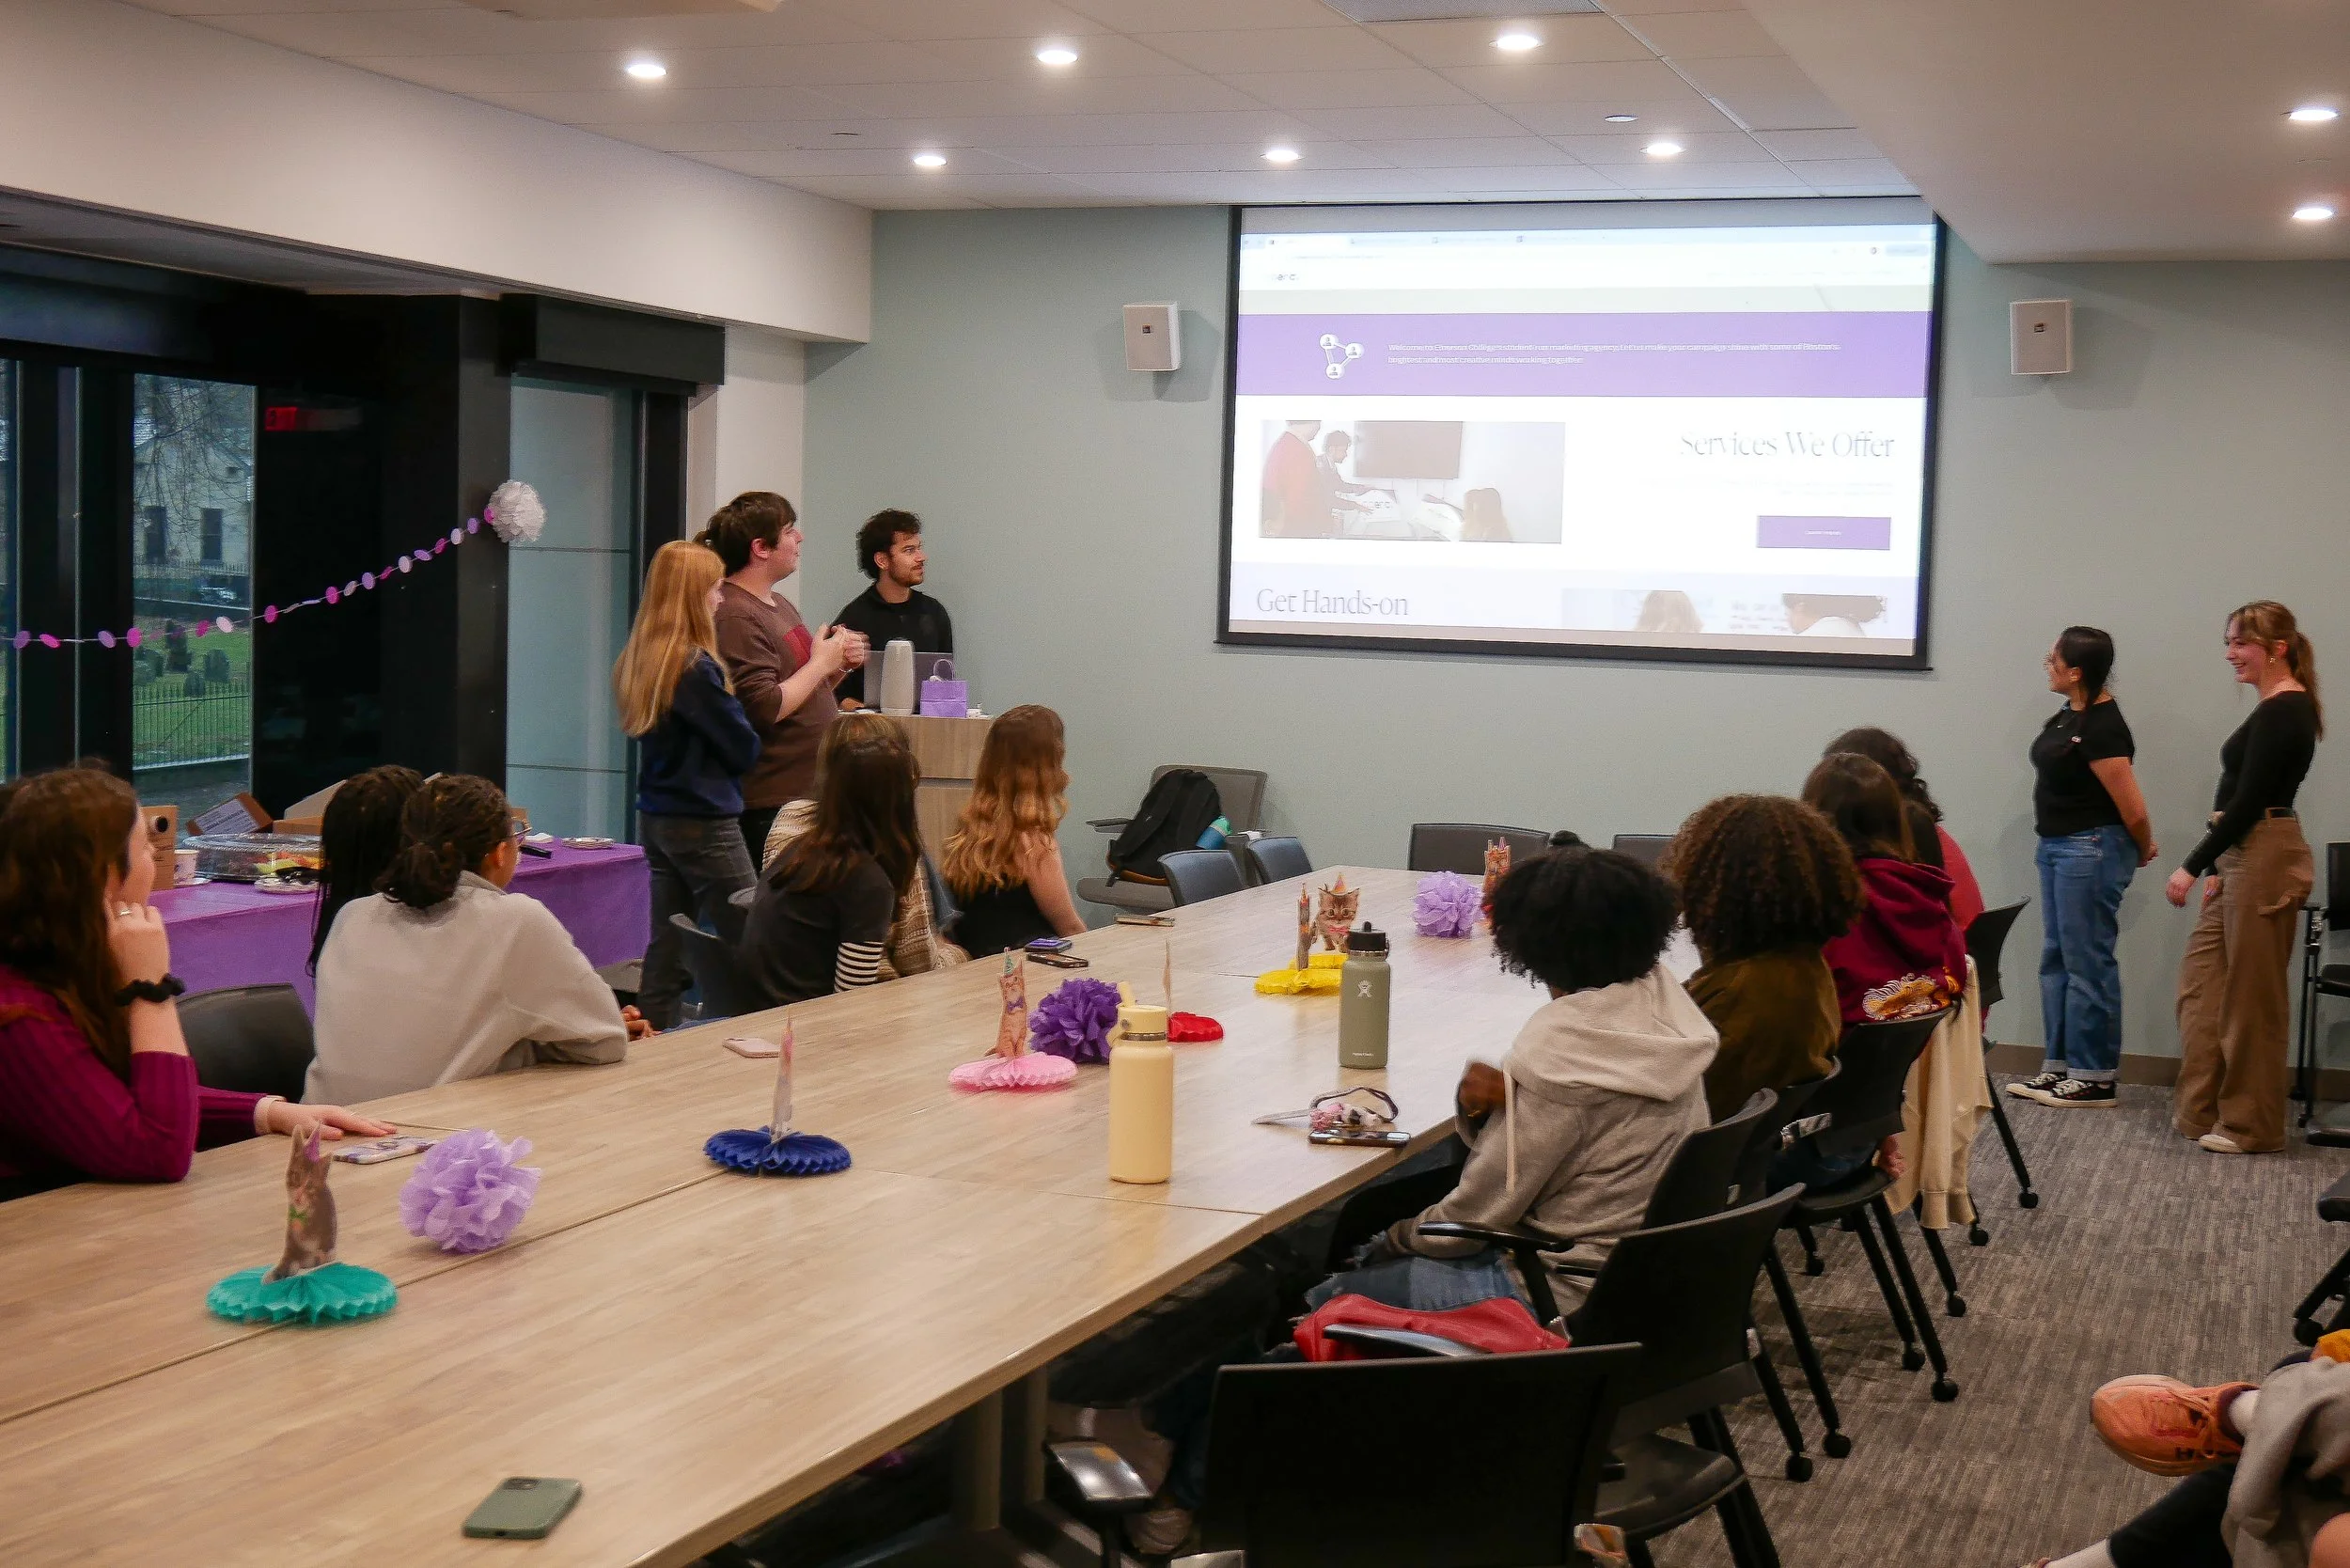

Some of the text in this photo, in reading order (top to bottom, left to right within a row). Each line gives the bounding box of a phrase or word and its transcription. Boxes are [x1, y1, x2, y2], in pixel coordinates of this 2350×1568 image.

[1680, 430, 1896, 458] Services We Offer
[1256, 588, 1410, 617] Get Hands-on
